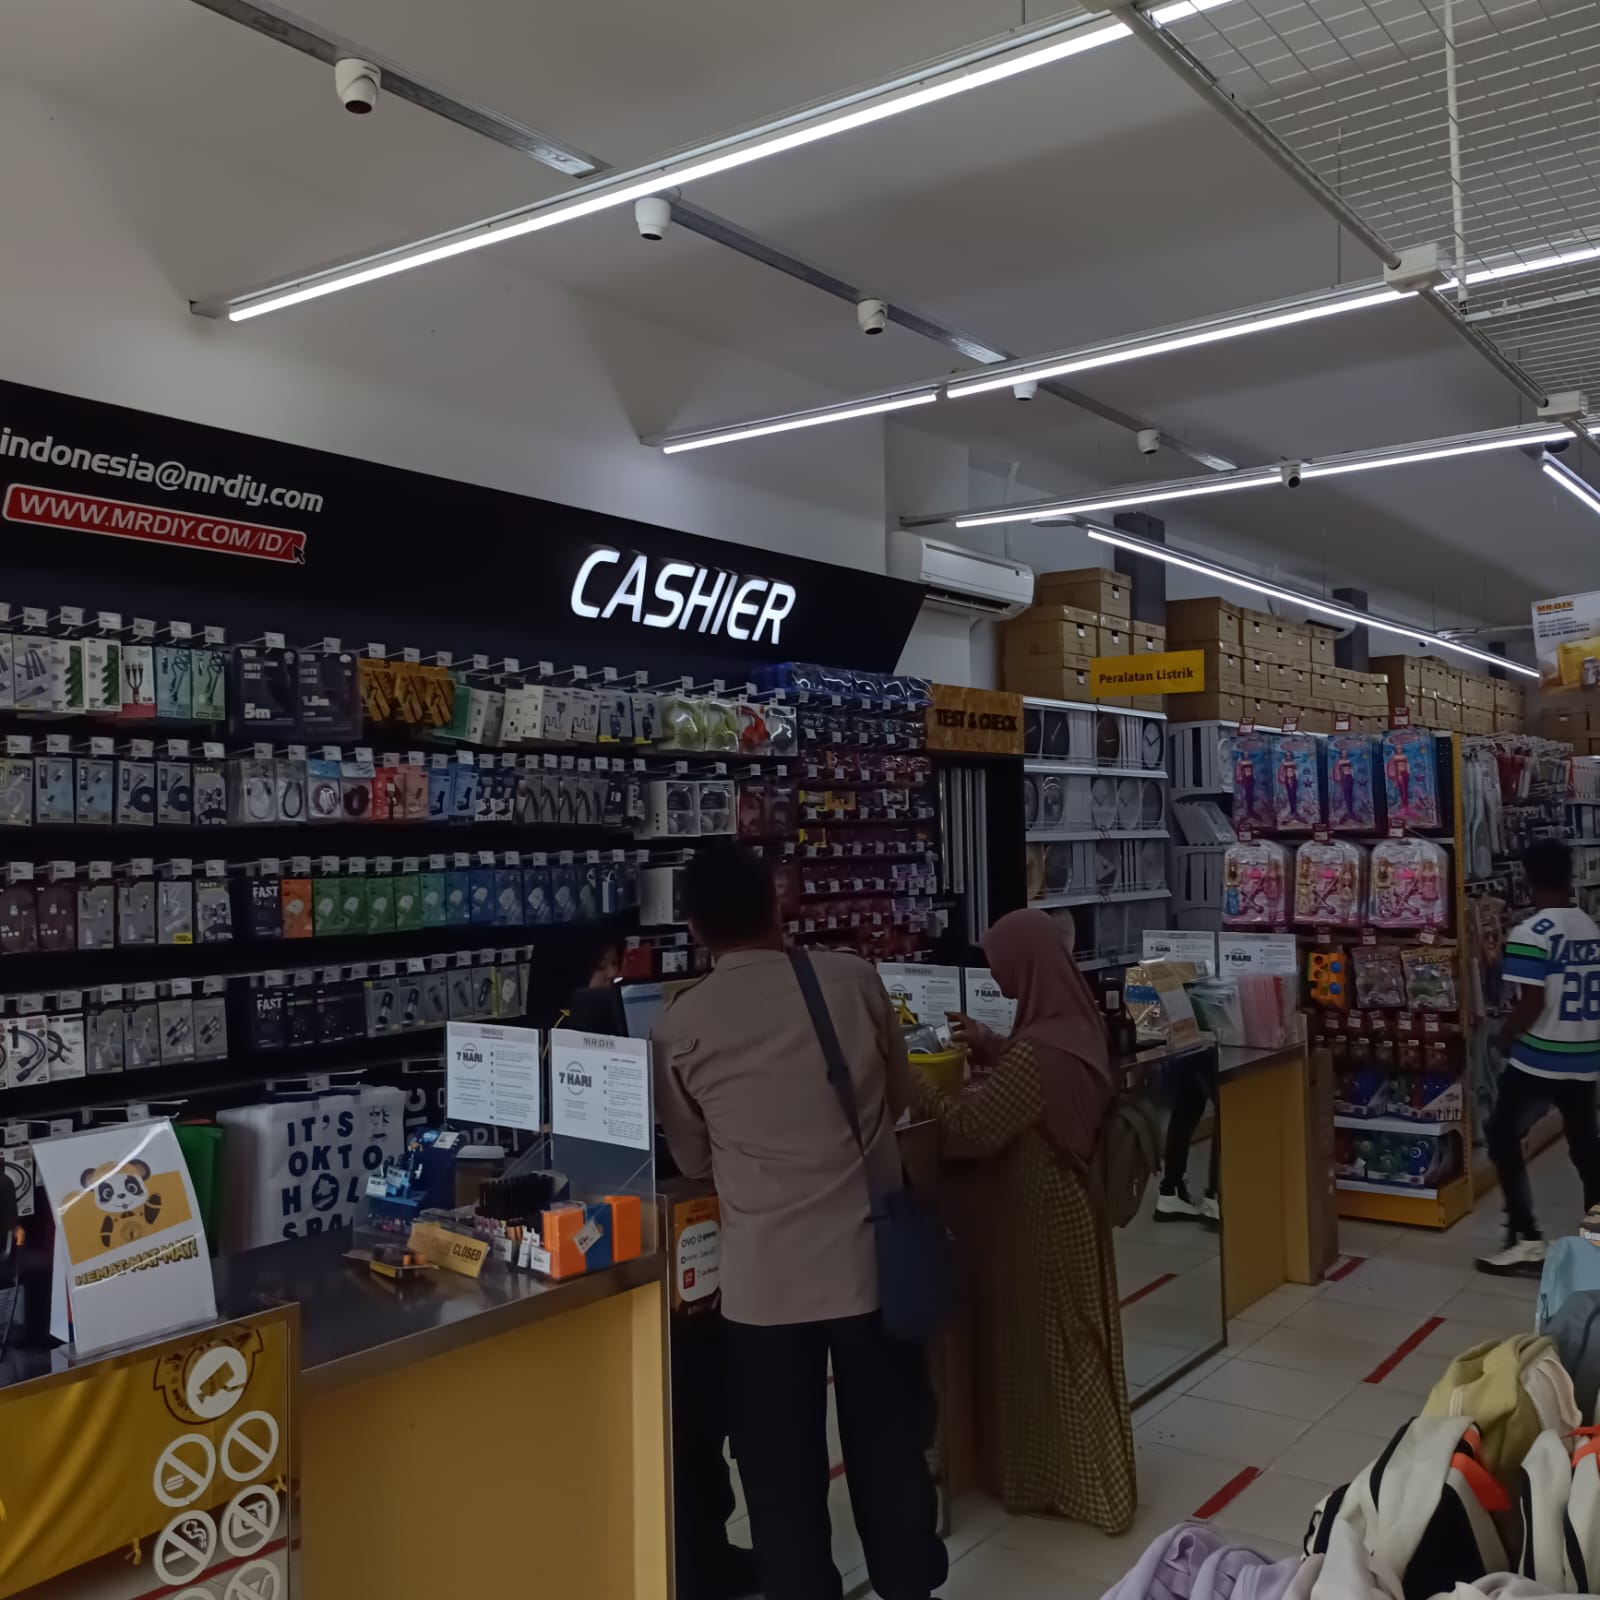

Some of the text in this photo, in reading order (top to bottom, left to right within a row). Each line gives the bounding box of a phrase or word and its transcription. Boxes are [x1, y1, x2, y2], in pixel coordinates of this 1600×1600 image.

[0, 426, 325, 513] indonesia@mrdiy.com
[19, 491, 294, 555] WWW.MRDIY.COM/ID/
[570, 547, 797, 645] CASHIER
[1099, 667, 1194, 684] Peralatan Listrik
[935, 708, 1018, 732] TEST & CHECK
[252, 885, 280, 899] FAST
[256, 997, 283, 1011] FAST
[463, 1052, 483, 1063] HARI
[559, 1071, 593, 1088] 7 HARI
[287, 1111, 354, 1147] IT'S
[453, 1243, 483, 1262] CLOSED
